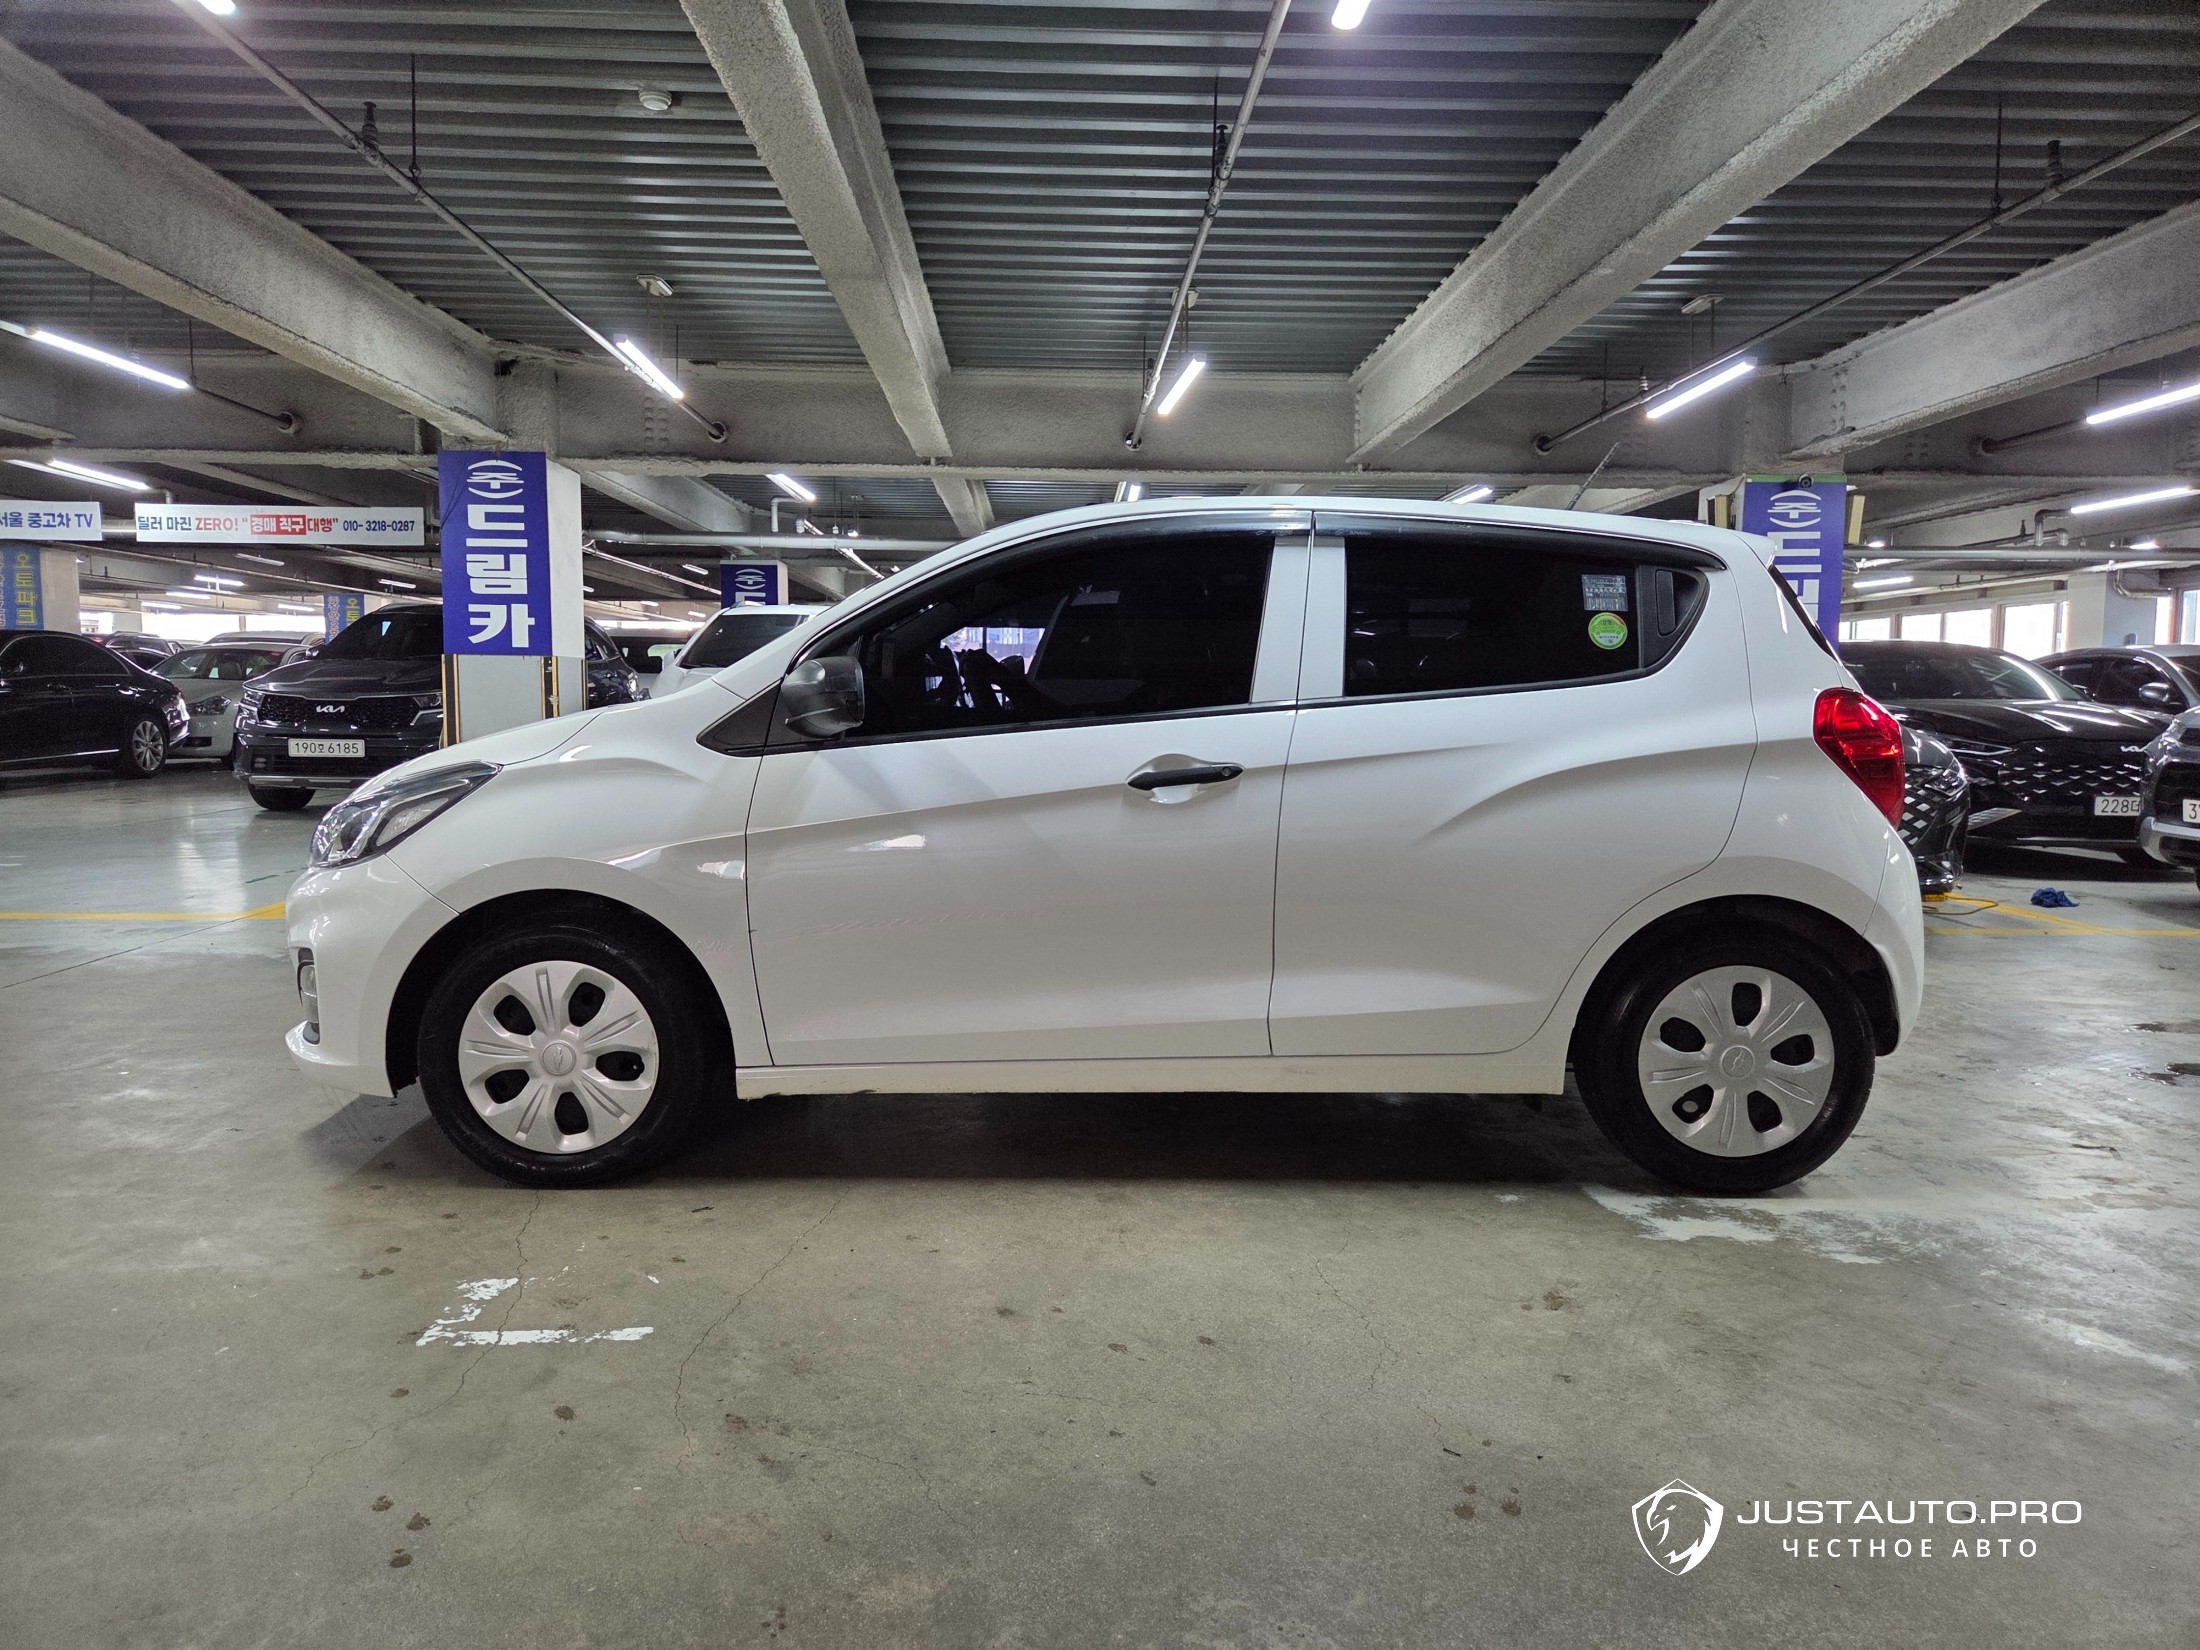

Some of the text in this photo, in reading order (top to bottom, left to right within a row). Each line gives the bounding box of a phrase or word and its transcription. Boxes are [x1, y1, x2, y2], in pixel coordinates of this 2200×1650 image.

[28, 512, 71, 528] 중고차
[74, 513, 93, 528] TV
[138, 516, 162, 530] 딜러
[166, 517, 192, 531] 마진
[195, 517, 239, 531] ZERO!
[466, 459, 535, 648] (주)드림카
